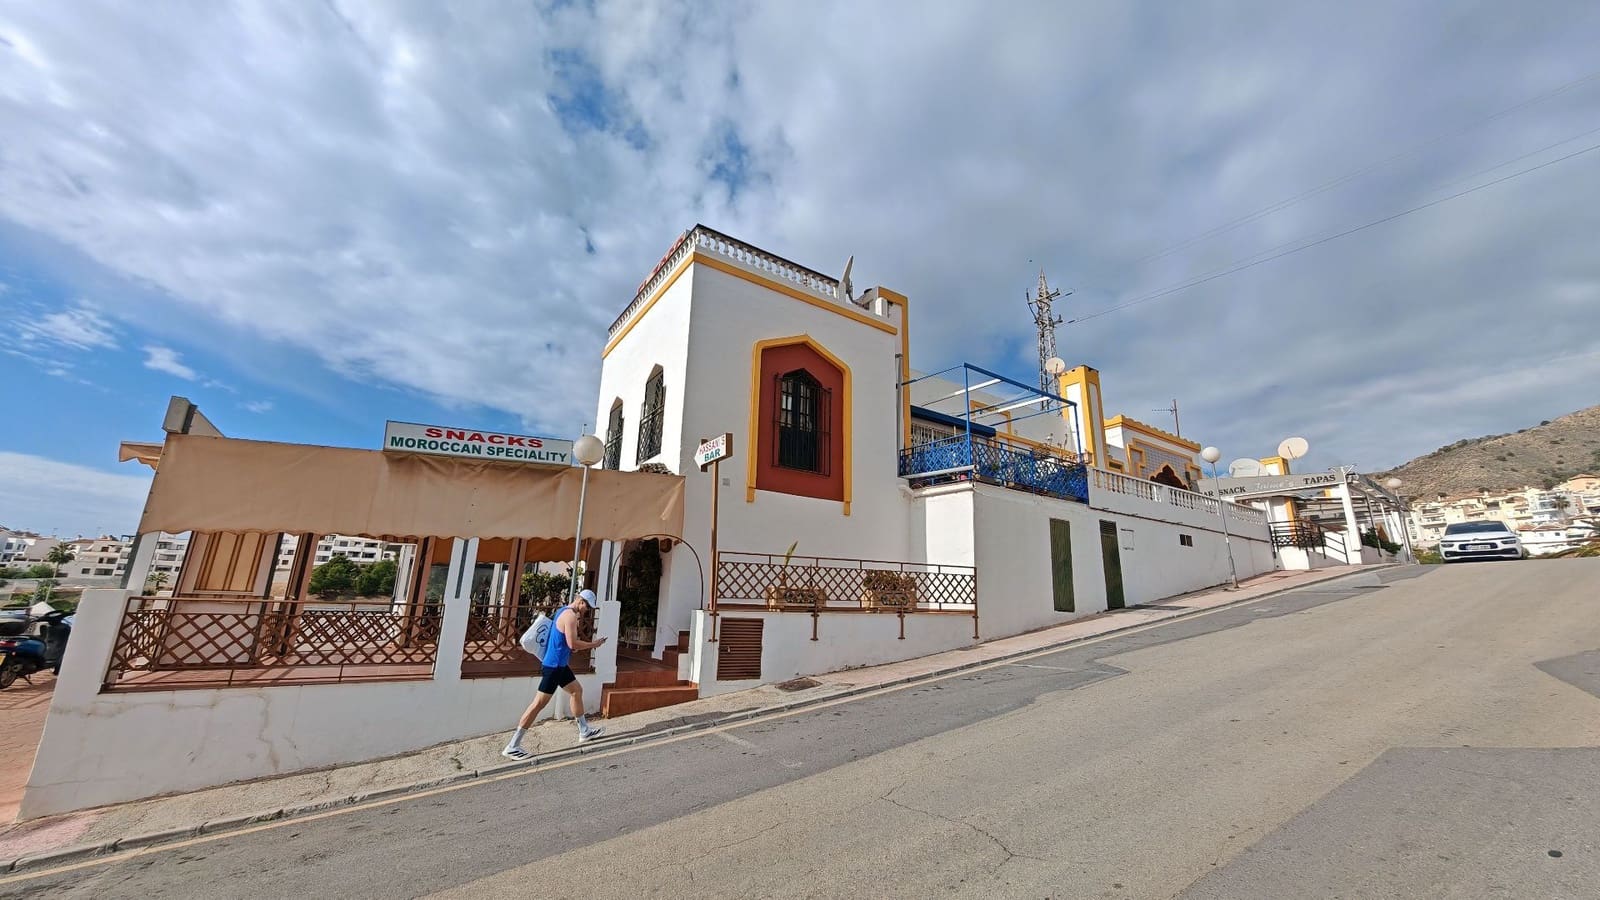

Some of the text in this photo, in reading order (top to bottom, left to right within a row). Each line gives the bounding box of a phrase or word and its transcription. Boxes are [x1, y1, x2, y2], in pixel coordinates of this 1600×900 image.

[425, 427, 544, 448] SNACKS
[390, 436, 567, 462] MOROCCAN SPECIALITY
[704, 448, 721, 462] BAR
[1218, 486, 1246, 496] SNACK
[1303, 474, 1336, 485] TAPAS
